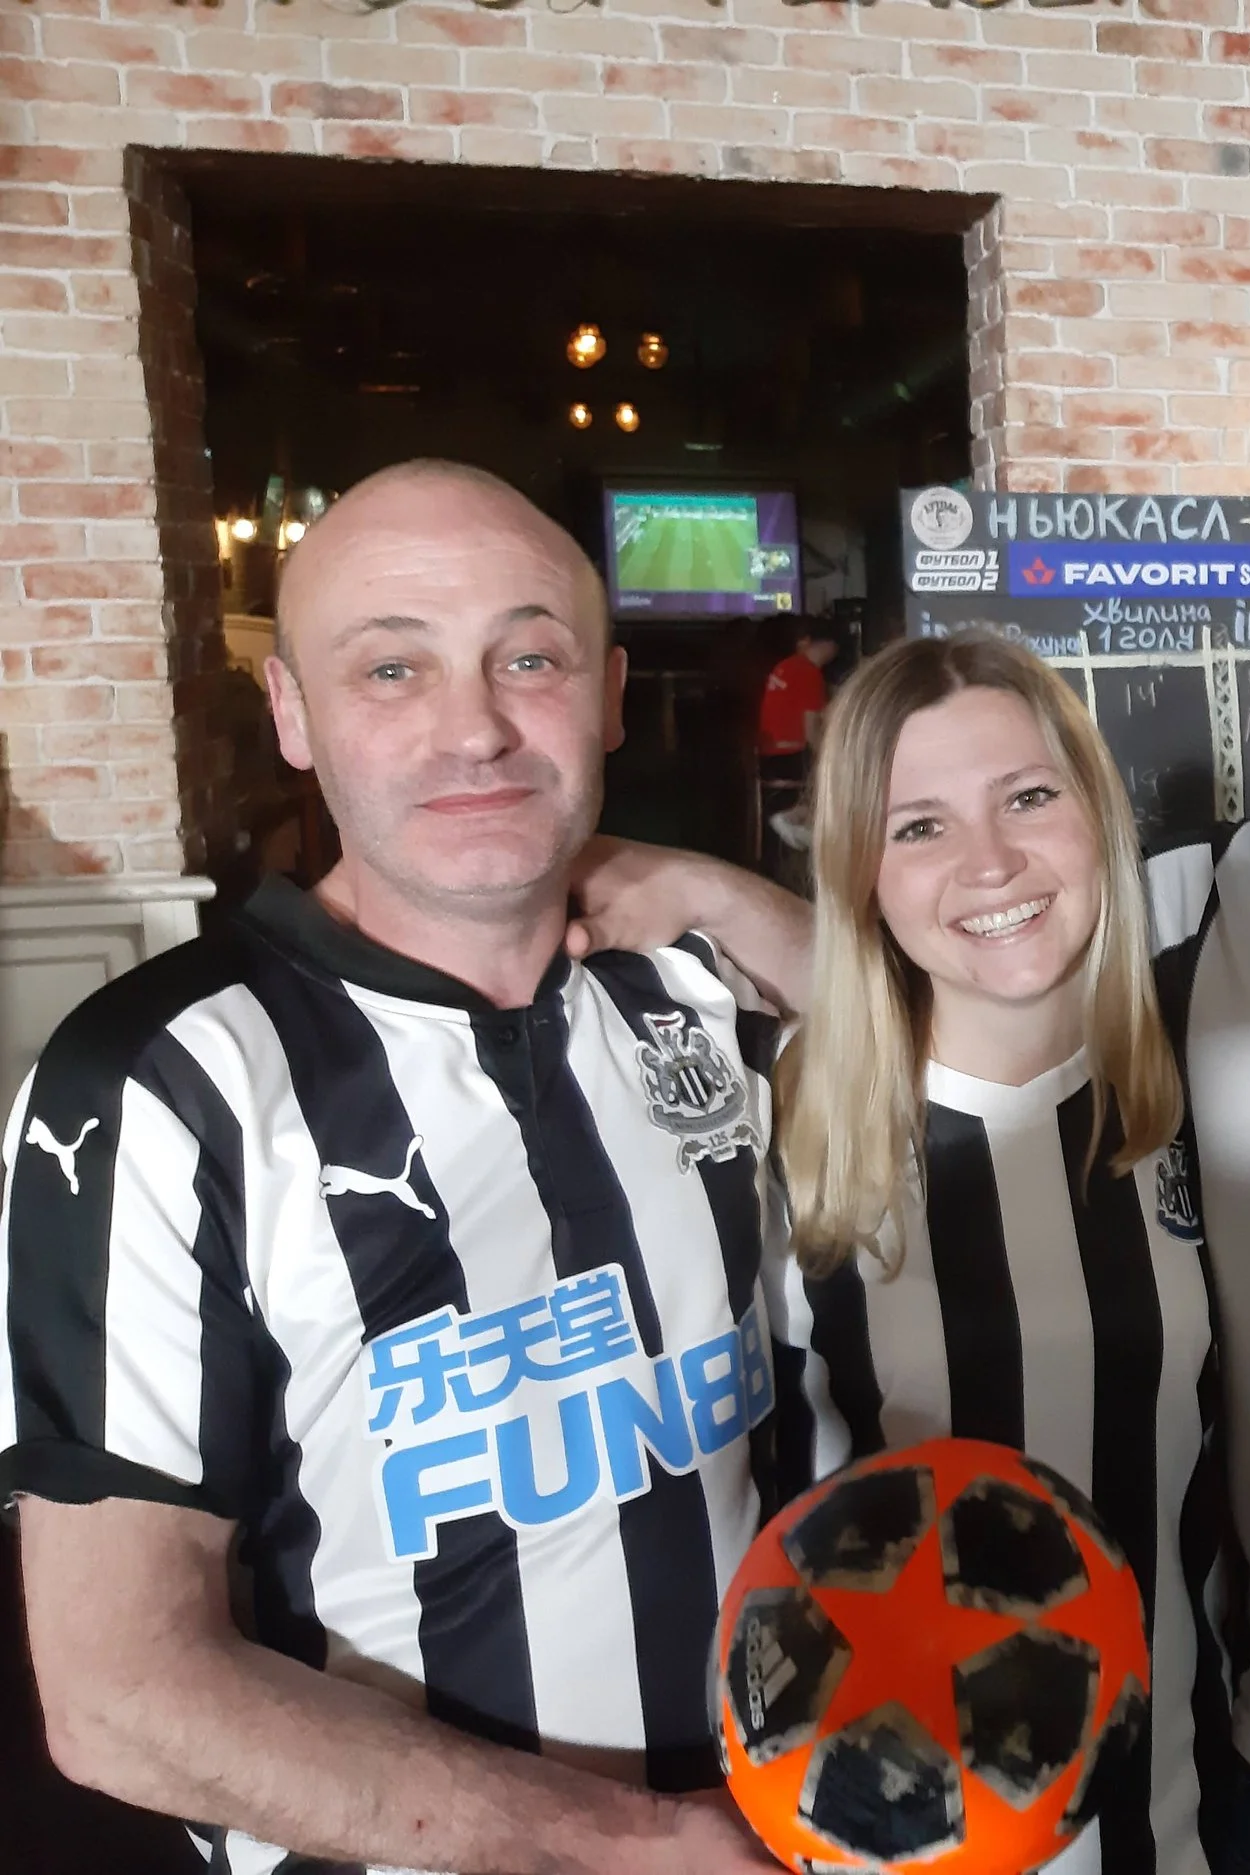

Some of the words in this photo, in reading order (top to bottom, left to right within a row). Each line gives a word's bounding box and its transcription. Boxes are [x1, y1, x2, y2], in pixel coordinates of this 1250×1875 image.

[989, 497, 1231, 543] НЬЮКАСЛ
[920, 554, 979, 566] ФУТБОЛ
[985, 551, 999, 570] 1
[1064, 562, 1235, 586] FAVORIT
[917, 575, 977, 587] ФУТБОЛ
[981, 571, 998, 591] 2
[369, 1271, 638, 1433] 乐天堂
[381, 1304, 774, 1557] FUN88
